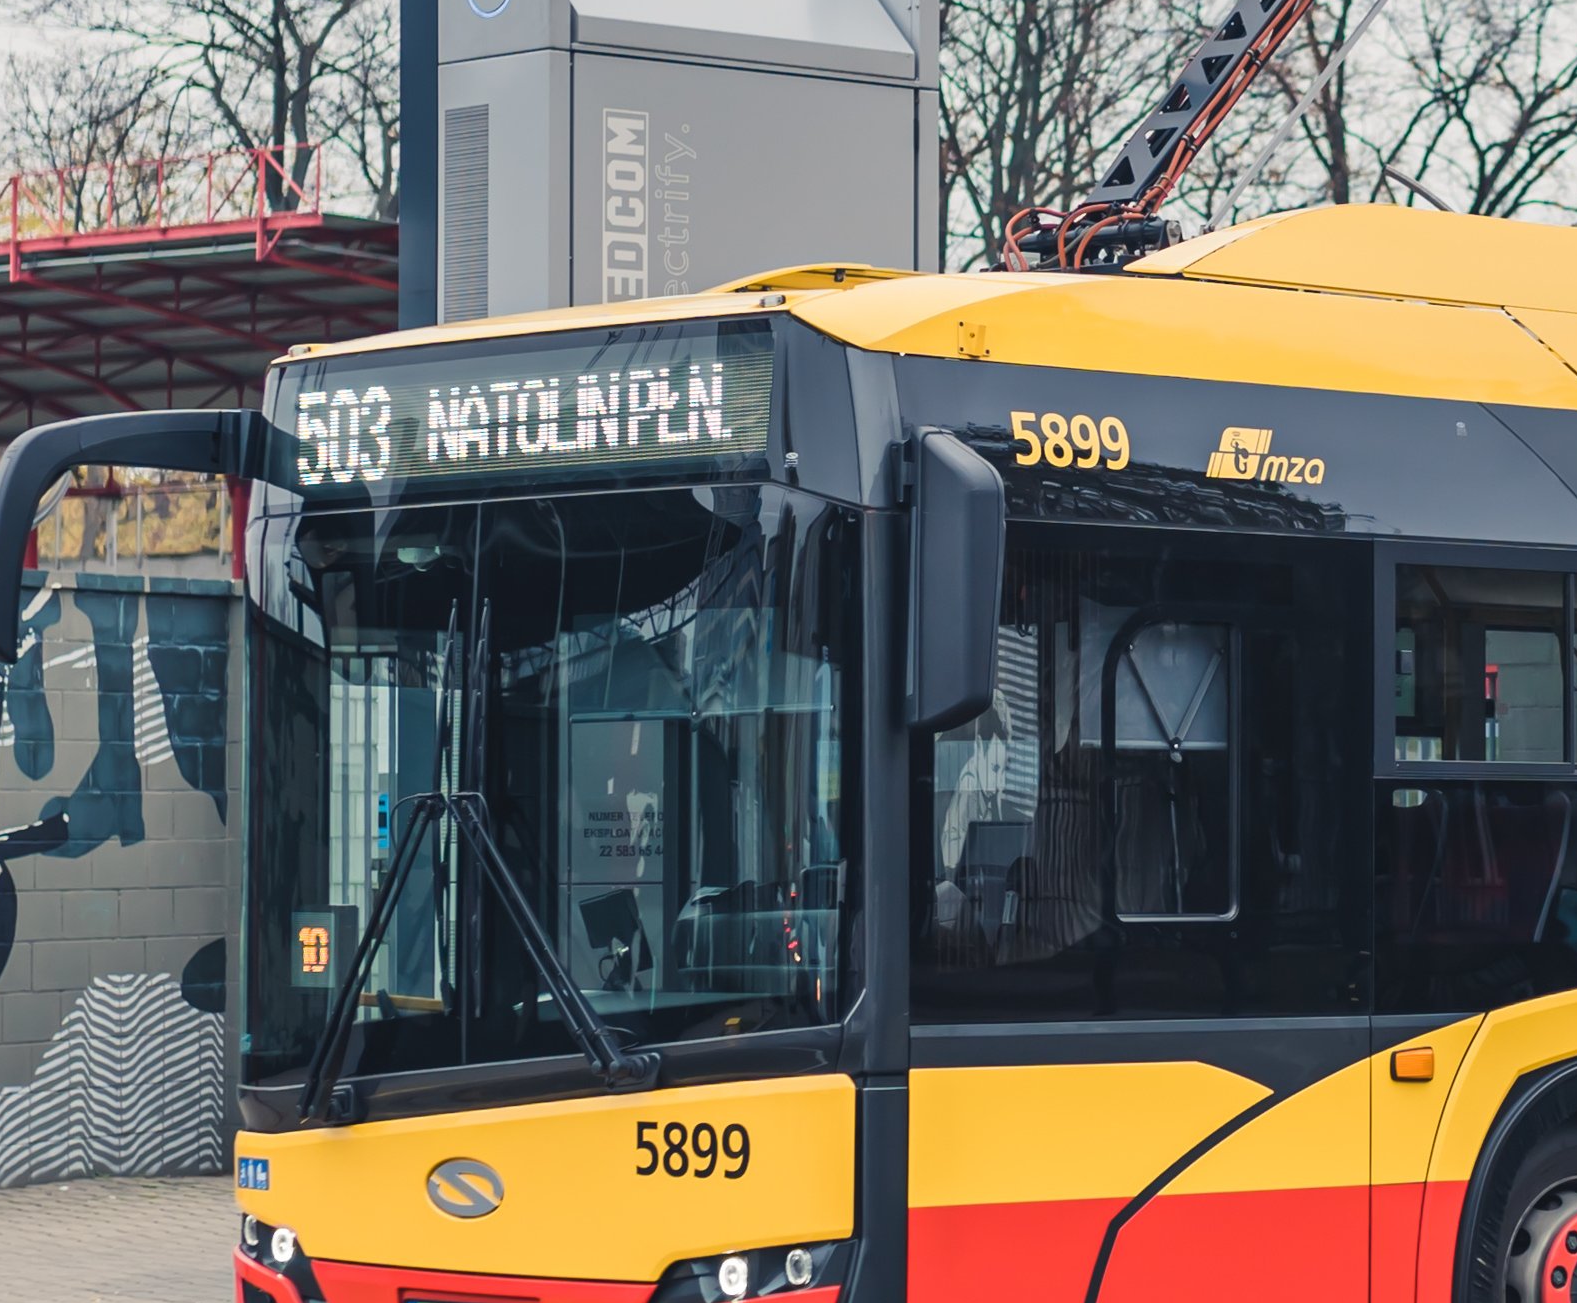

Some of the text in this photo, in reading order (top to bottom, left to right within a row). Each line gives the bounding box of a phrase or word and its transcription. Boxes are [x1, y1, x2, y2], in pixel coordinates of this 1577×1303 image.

[605, 116, 646, 303] EDCOM
[297, 386, 392, 485] 503
[427, 373, 620, 462] NATOLIN
[1010, 411, 1130, 471] 5899
[1260, 455, 1325, 484] mza
[636, 1121, 751, 1180] 5899
